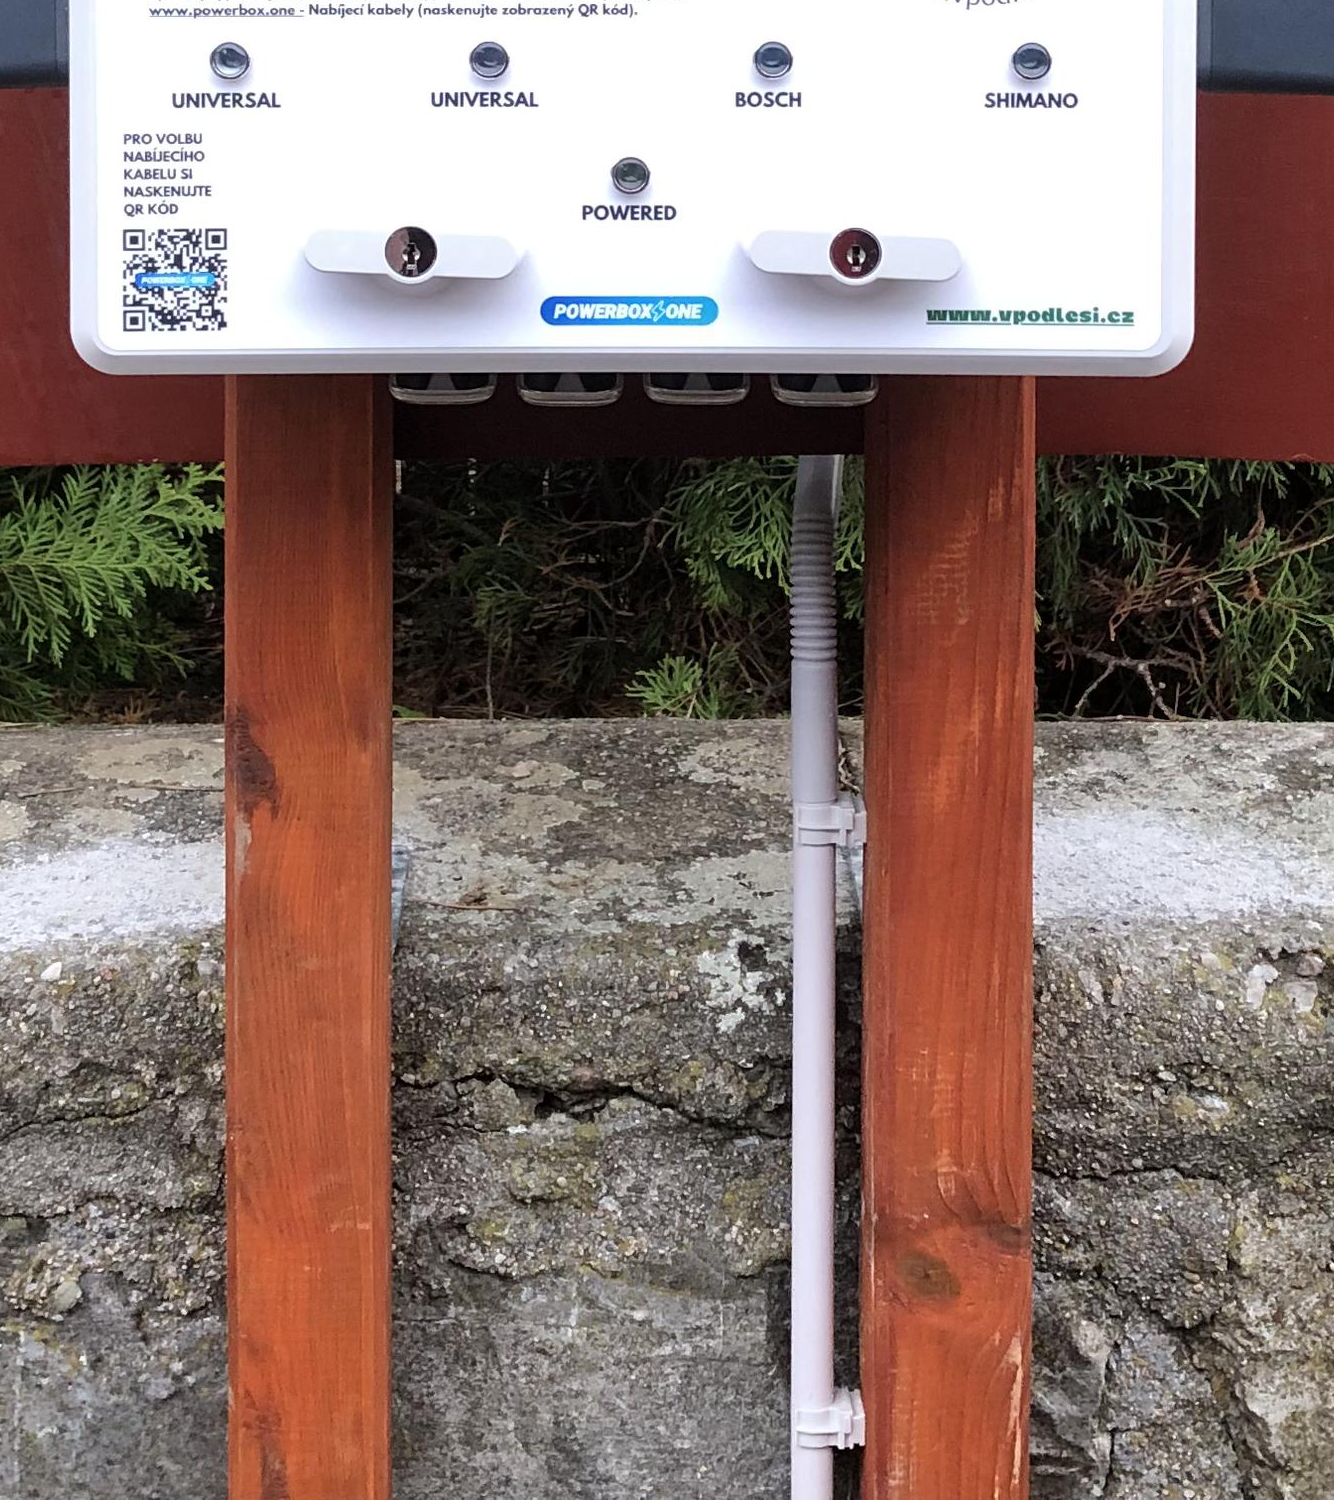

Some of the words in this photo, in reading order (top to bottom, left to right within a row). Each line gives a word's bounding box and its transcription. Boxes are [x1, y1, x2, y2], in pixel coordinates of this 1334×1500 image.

[148, 3, 296, 19] www.powerbox.one
[308, 3, 365, 20] Nabíjecí
[367, 3, 414, 20] kabely
[417, 3, 498, 20] (naskenujte
[502, 3, 575, 20] zobrazený
[577, 3, 599, 18] QR
[602, 3, 638, 18] kód).
[171, 91, 282, 109] UNIVERSAL
[430, 91, 540, 108] UNIVERSAL
[735, 91, 802, 108] BOSCH
[984, 92, 1079, 109] SHIMANO
[123, 133, 153, 145] PRO
[155, 133, 203, 145] VOLBU
[123, 147, 205, 163] NABÍJECÍHO
[123, 168, 177, 181] KABELU
[180, 168, 193, 180] SI
[123, 185, 212, 198] NASKENUJTE
[123, 203, 145, 218] QR
[147, 199, 179, 215] KÓD
[581, 204, 677, 221] POWERED
[552, 302, 654, 321] POWERBOX
[664, 302, 705, 320] ONE
[925, 306, 1135, 327] www.vpodlesi.cz
